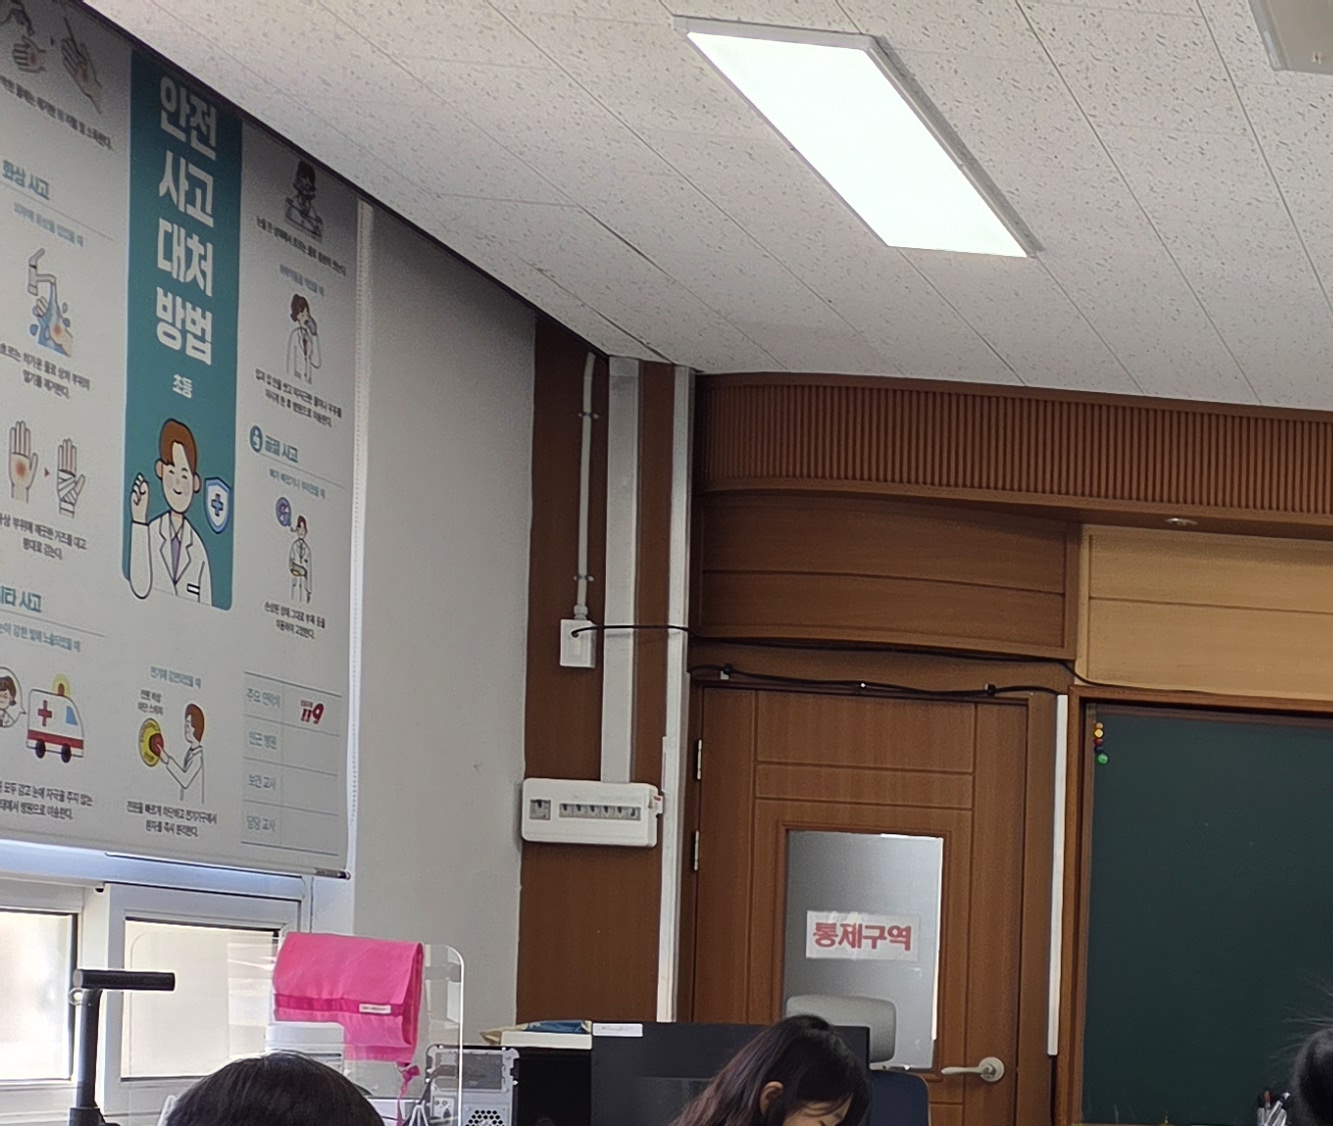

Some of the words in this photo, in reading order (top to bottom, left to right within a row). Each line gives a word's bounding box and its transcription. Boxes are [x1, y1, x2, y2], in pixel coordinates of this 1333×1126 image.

[159, 75, 217, 160] 안전
[28, 173, 50, 201] 사고
[158, 150, 215, 228] 사고
[157, 217, 213, 297] 대처
[156, 286, 212, 366] 방법
[19, 590, 42, 613] 사고
[300, 702, 324, 725] 119
[812, 921, 912, 952] 통제구역
